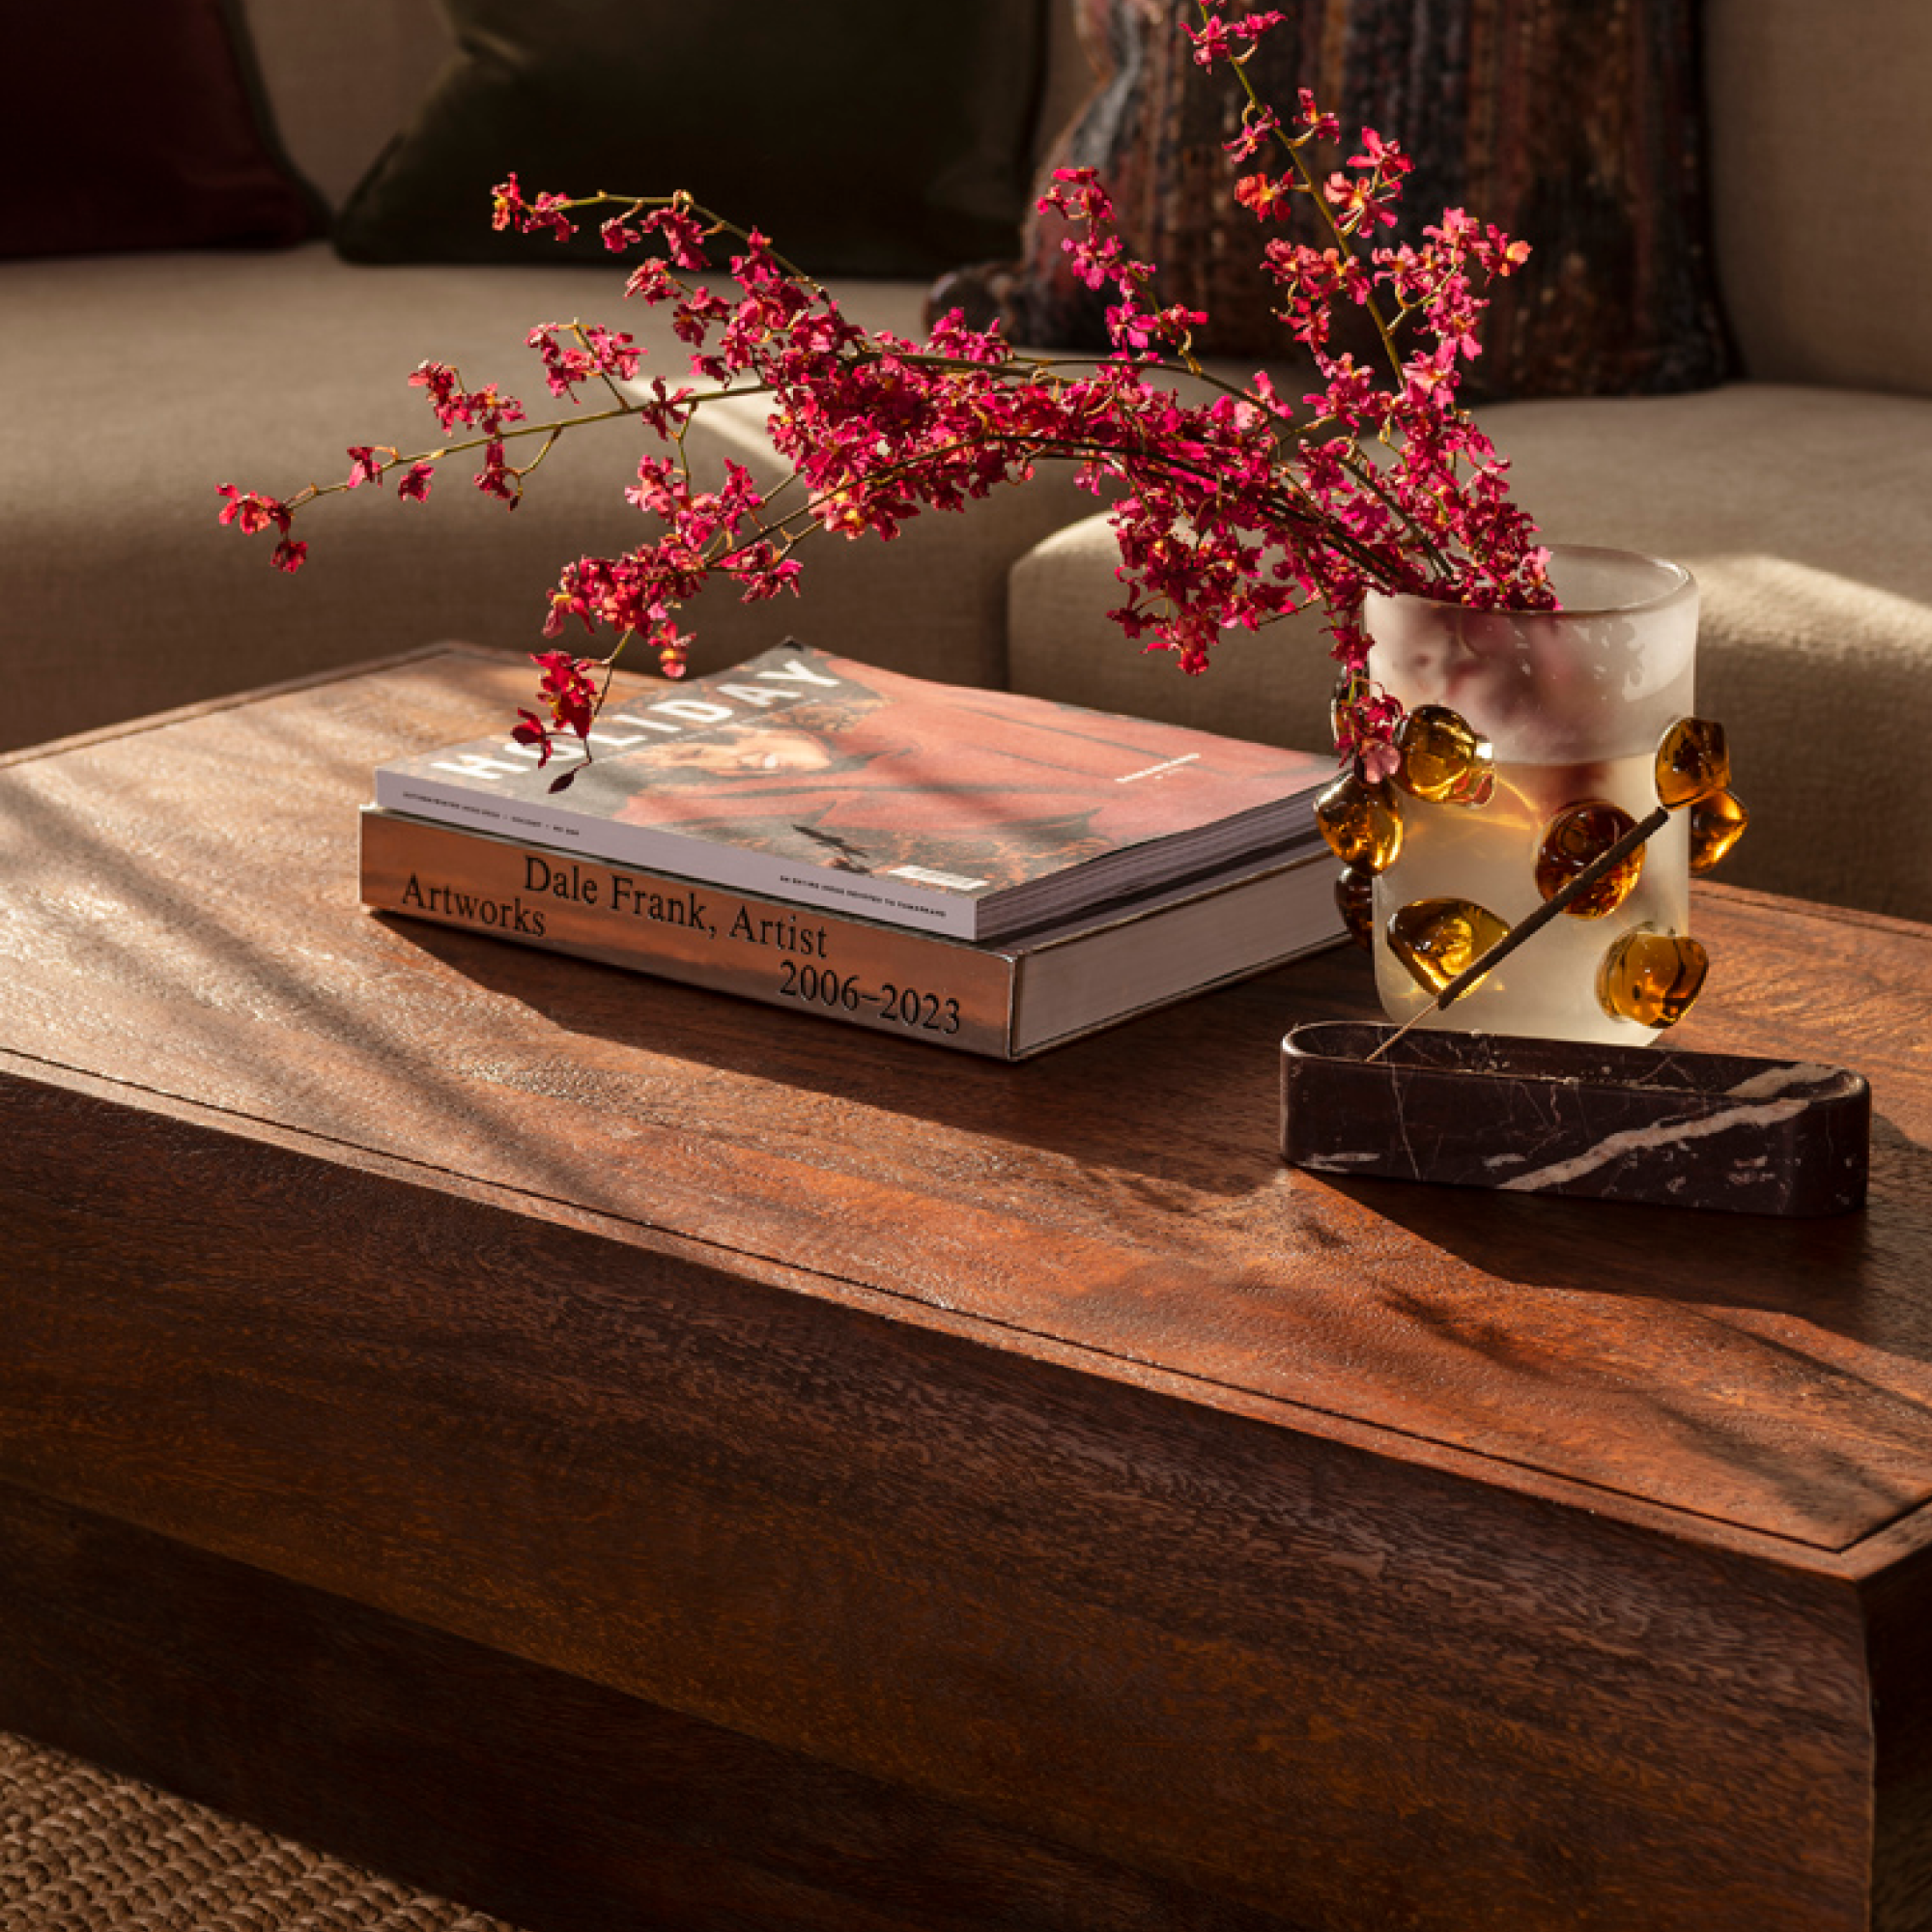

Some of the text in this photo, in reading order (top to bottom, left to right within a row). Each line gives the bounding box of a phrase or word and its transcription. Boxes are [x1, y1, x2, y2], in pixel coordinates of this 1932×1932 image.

[401, 872, 546, 937] Artworks
[524, 855, 598, 904] Dale
[610, 873, 717, 940] Frank,
[729, 903, 828, 958] Artist
